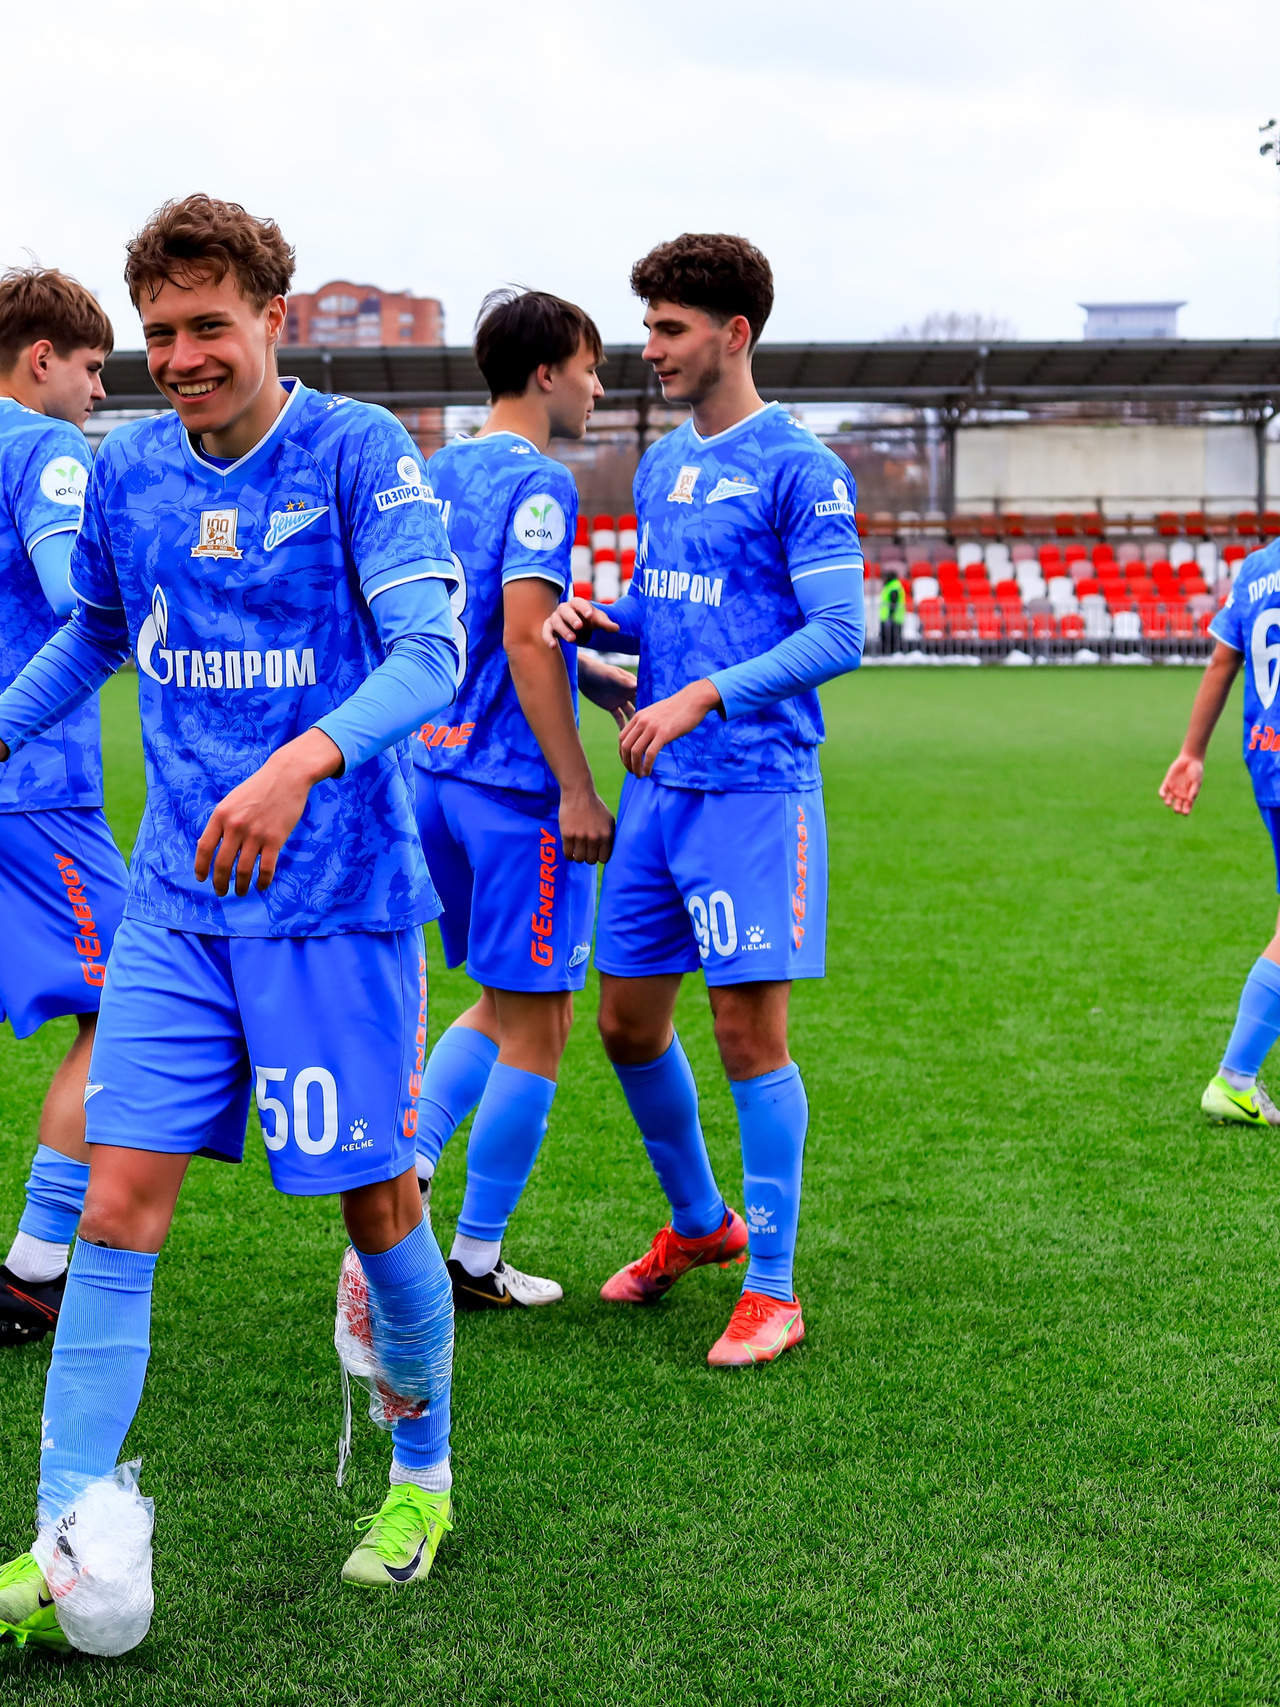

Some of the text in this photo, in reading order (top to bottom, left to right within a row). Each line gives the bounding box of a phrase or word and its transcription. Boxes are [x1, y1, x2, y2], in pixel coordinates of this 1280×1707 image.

[643, 568, 723, 608] ГАЗПРОМ
[175, 648, 317, 690] ГАЗПРОМ
[687, 890, 738, 959] 90
[741, 942, 772, 951] KELME
[255, 1065, 339, 1156] 50
[341, 1139, 374, 1152] KELME
